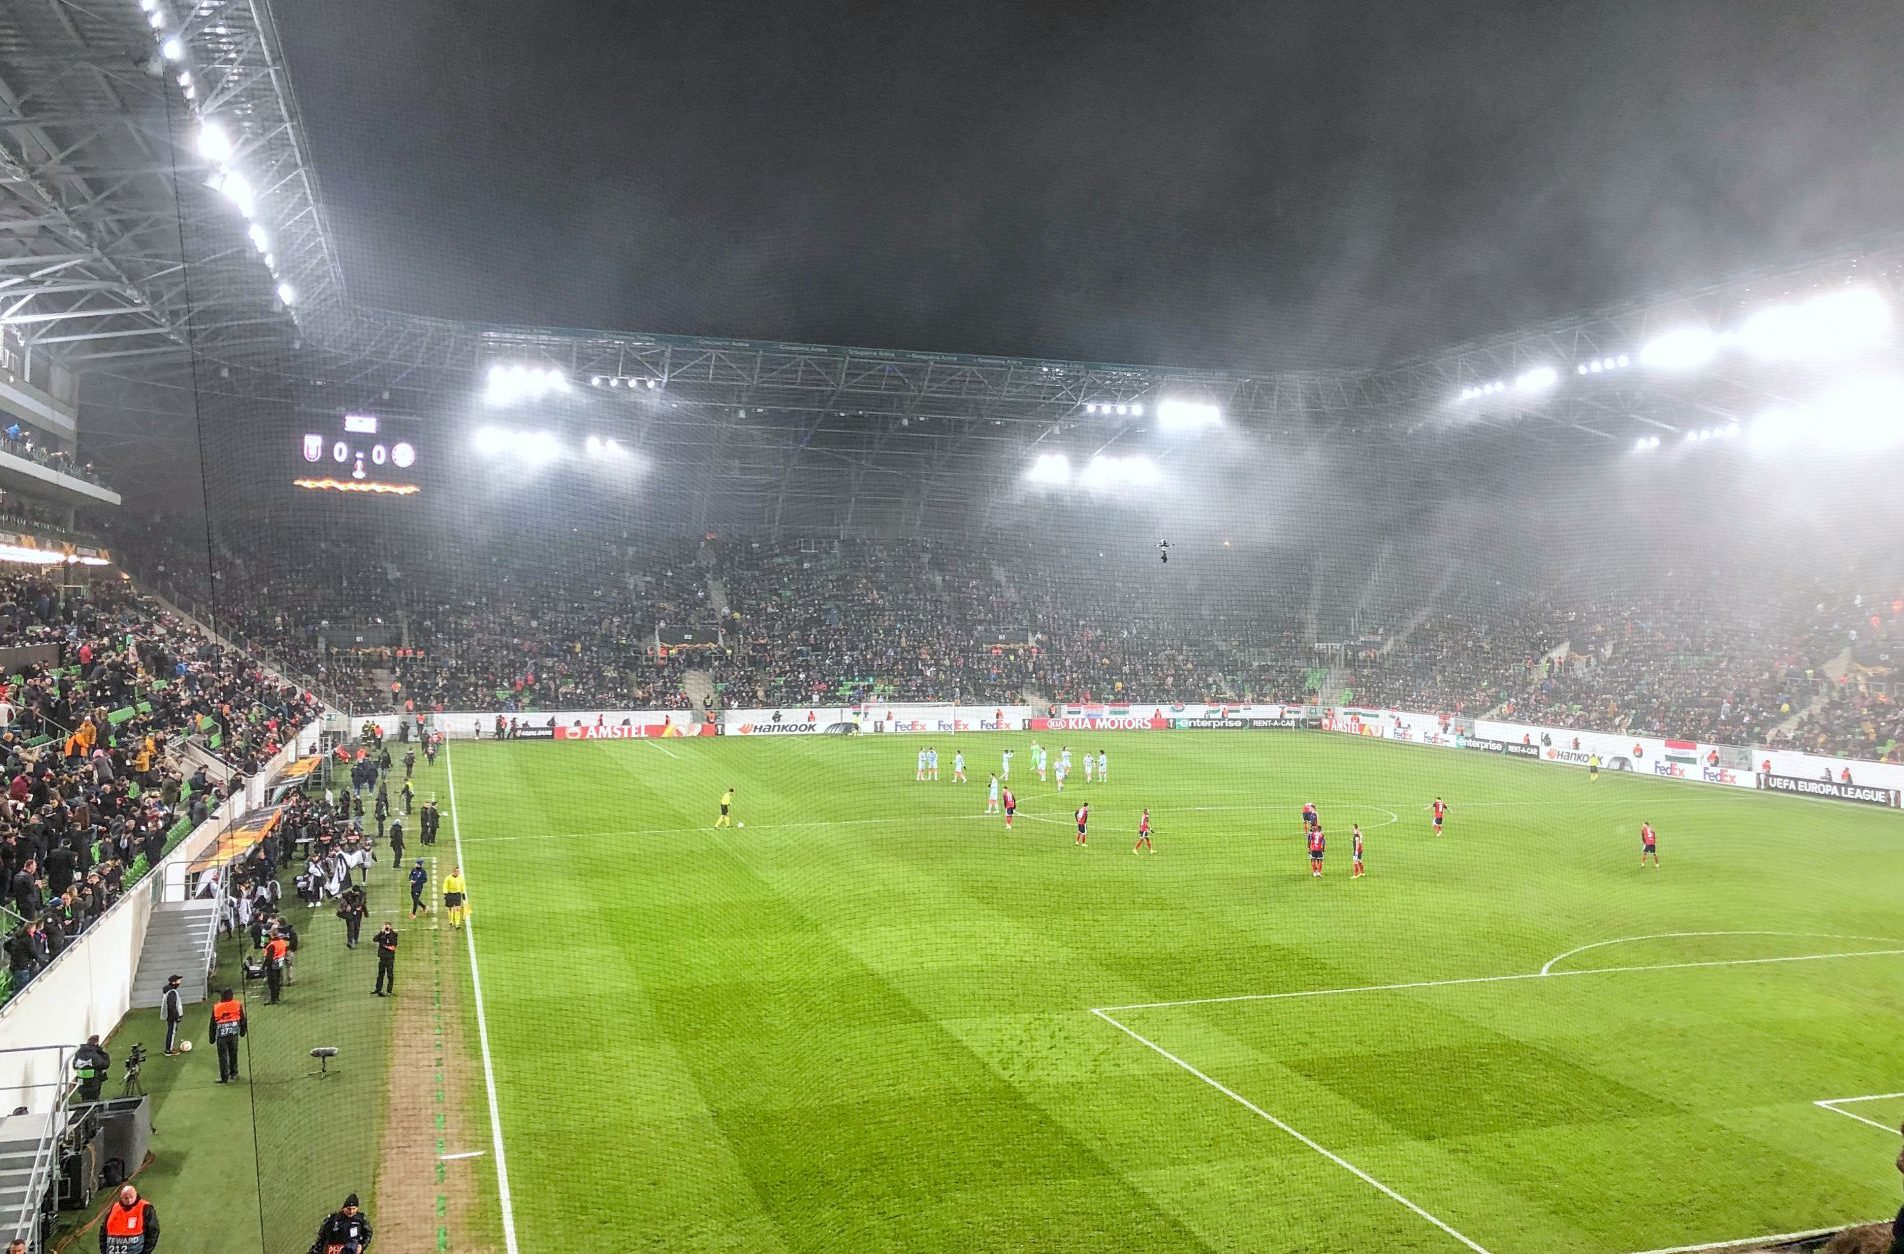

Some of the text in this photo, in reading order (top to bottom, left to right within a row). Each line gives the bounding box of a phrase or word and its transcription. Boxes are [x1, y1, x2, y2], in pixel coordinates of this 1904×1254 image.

[894, 720, 927, 732] FedEx
[980, 719, 1012, 730] FedEx
[1068, 718, 1092, 729] KIA
[1095, 718, 1152, 729] MOTORS
[1179, 717, 1243, 729] enterprise
[586, 724, 649, 739] AMSTEL
[1654, 760, 1686, 778] FedEx
[1703, 766, 1738, 785] FedEx
[1768, 776, 1887, 803] UEFA EUROPA LEAGUE
[108, 1245, 128, 1254] 212
